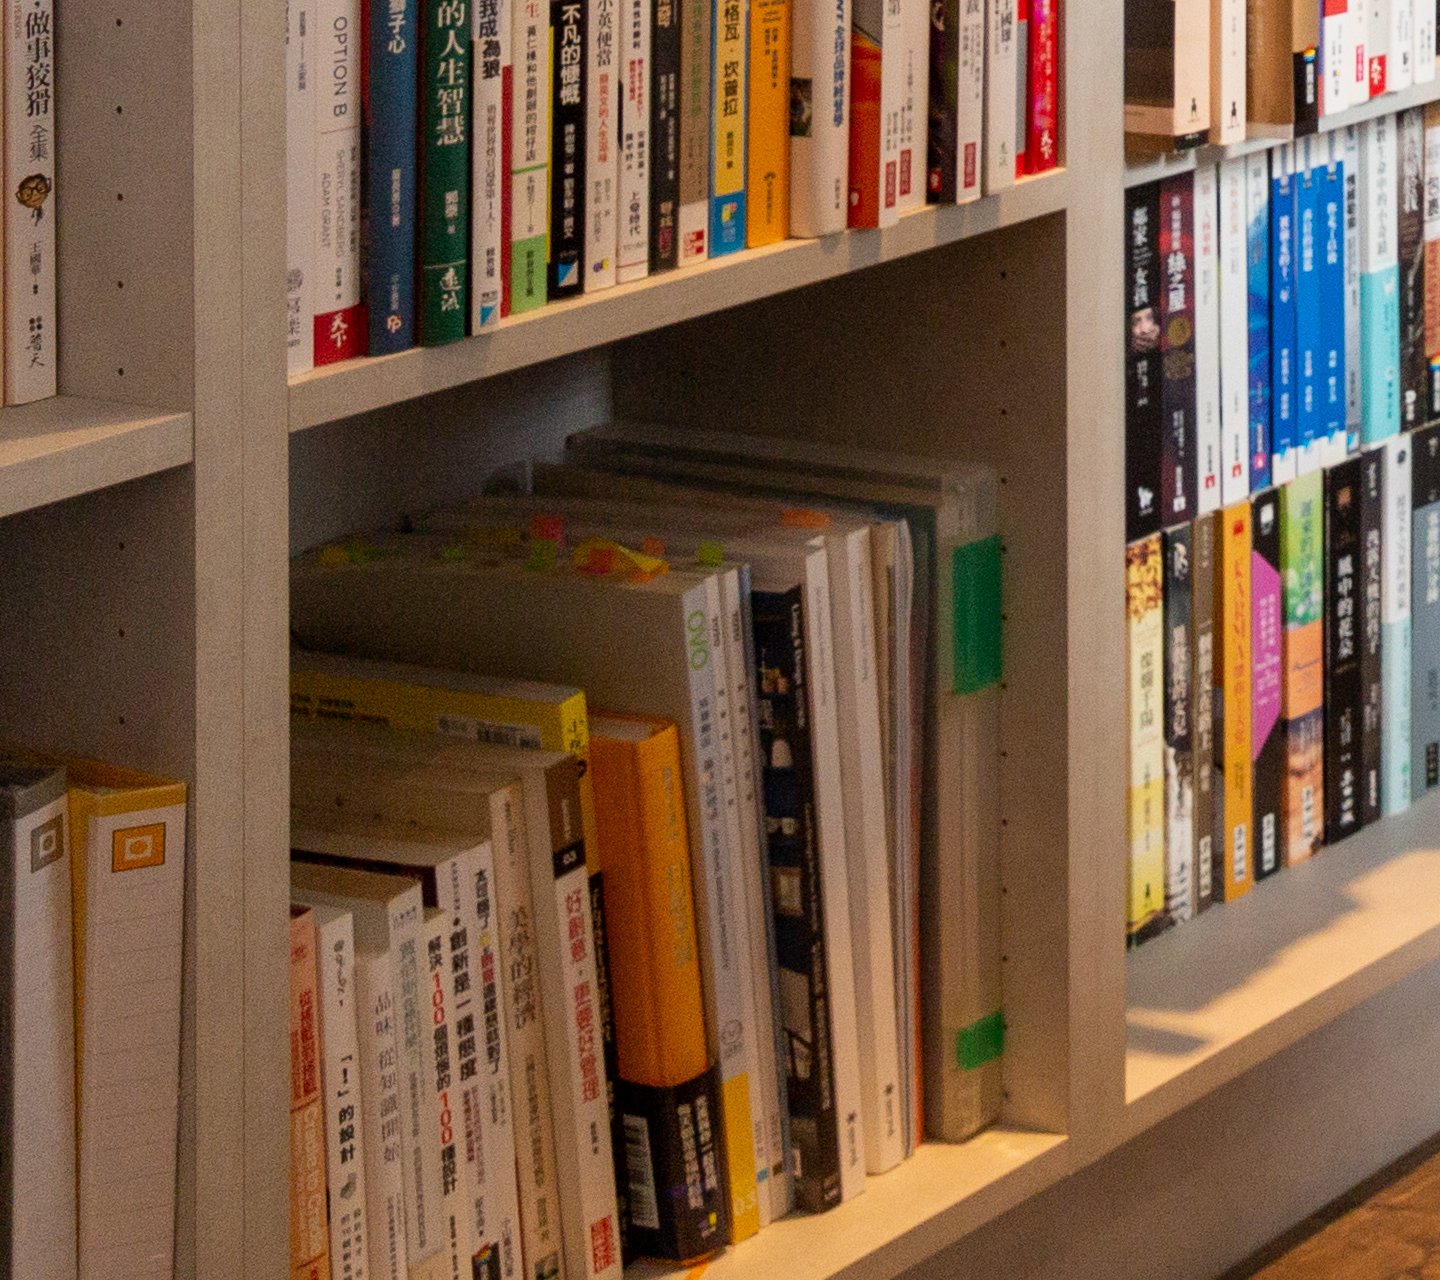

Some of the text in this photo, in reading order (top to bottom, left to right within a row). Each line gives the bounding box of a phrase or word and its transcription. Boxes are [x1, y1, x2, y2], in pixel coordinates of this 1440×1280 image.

[333, 16, 349, 118] OPTION B
[560, 4, 581, 106] 不凡的慷慨
[30, 124, 50, 162] 全集
[329, 314, 349, 349] 天下
